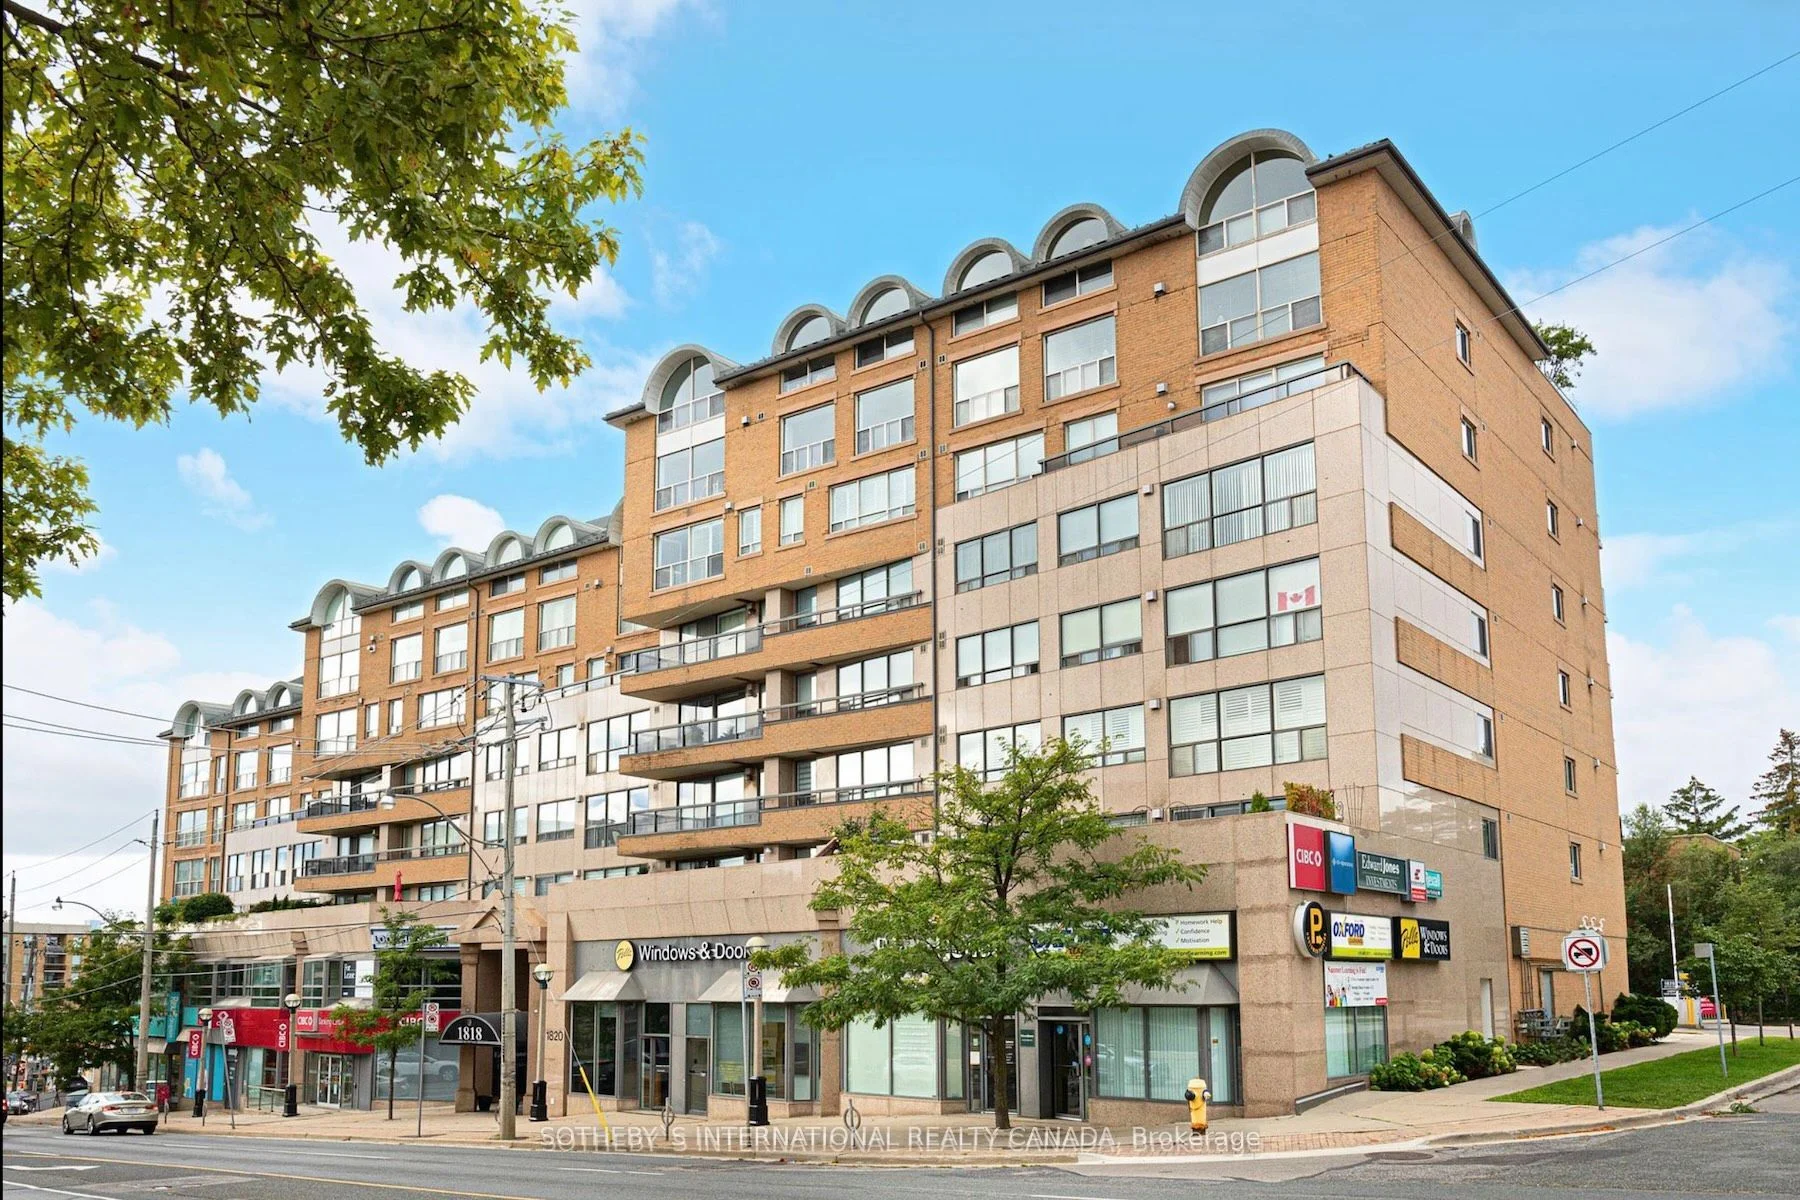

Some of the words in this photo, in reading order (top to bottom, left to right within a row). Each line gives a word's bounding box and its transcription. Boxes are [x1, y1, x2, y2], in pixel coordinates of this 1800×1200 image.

[1296, 848, 1314, 866] CIBC
[1333, 920, 1365, 938] OXFORD
[1400, 926, 1418, 950] Pella
[638, 944, 696, 961] Windows
[700, 941, 711, 960] &
[715, 942, 752, 960] Door
[297, 1016, 309, 1026] CIBC
[278, 1030, 287, 1048] CIBC
[458, 1027, 483, 1041] 1818
[546, 1030, 564, 1042] 1820
[191, 1040, 200, 1056] CIBC
